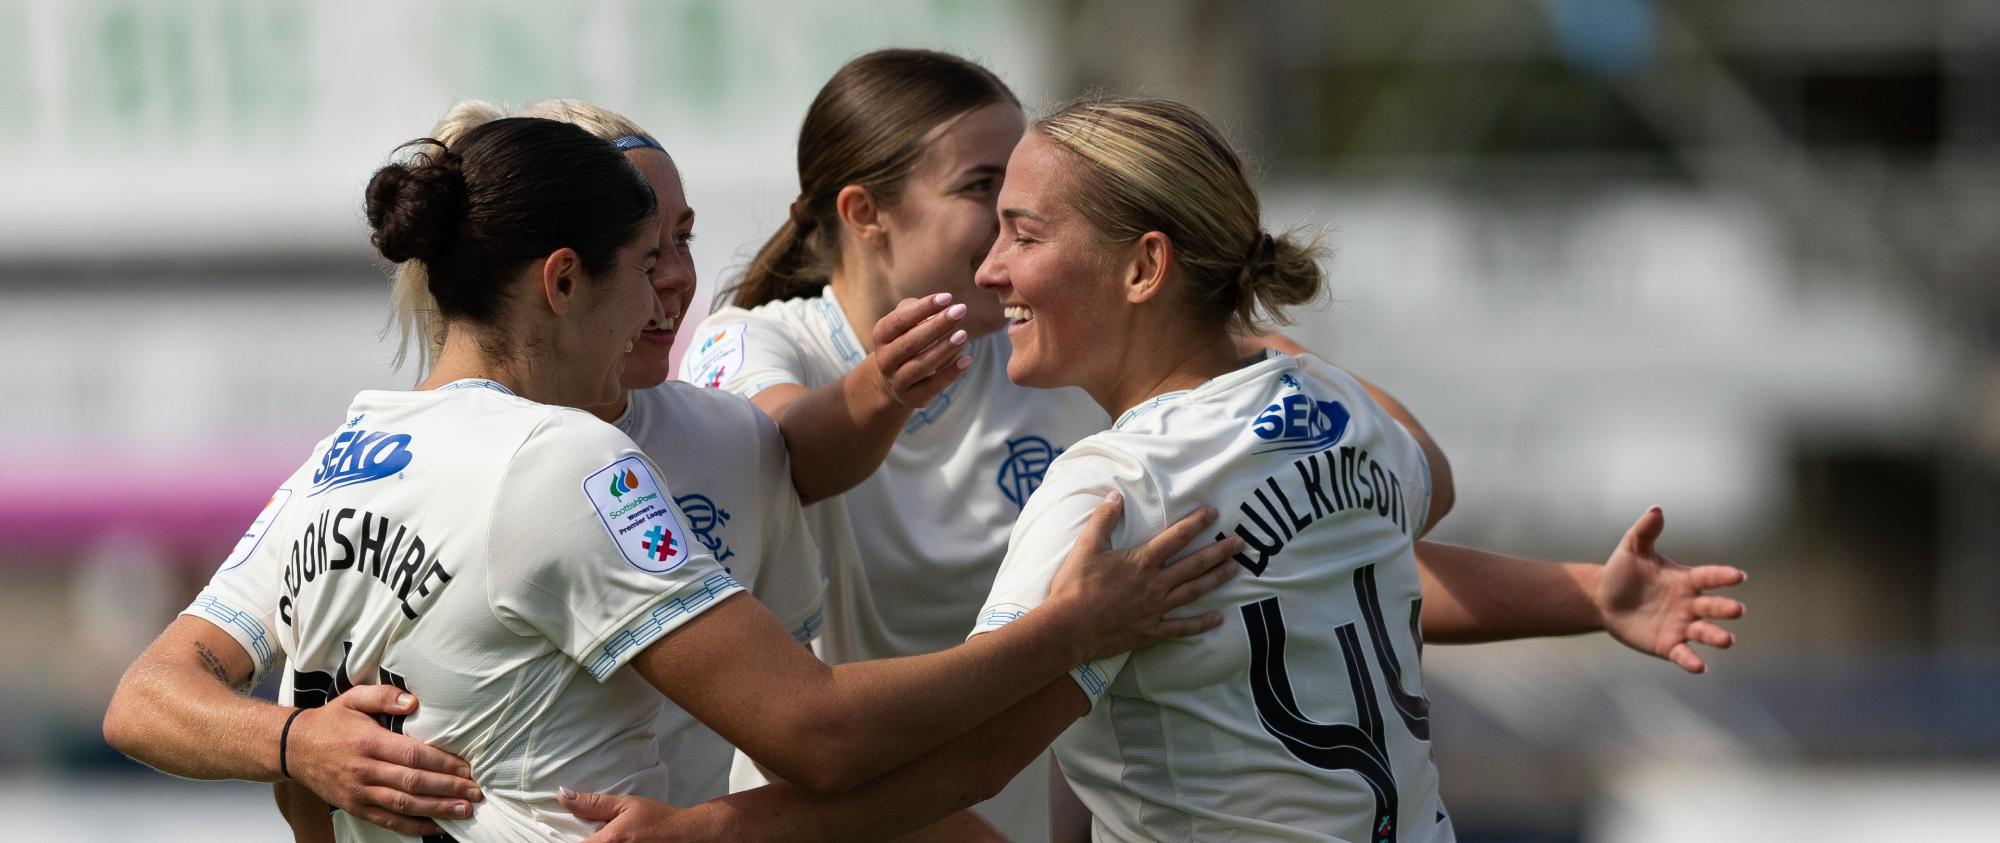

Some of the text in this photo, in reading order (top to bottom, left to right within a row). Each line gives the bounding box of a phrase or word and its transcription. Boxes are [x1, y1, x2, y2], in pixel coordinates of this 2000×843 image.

[312, 430, 413, 486] SEKO
[618, 517, 646, 535] Premier
[627, 504, 655, 521] Women's
[1215, 446, 1407, 577] WILKINSON
